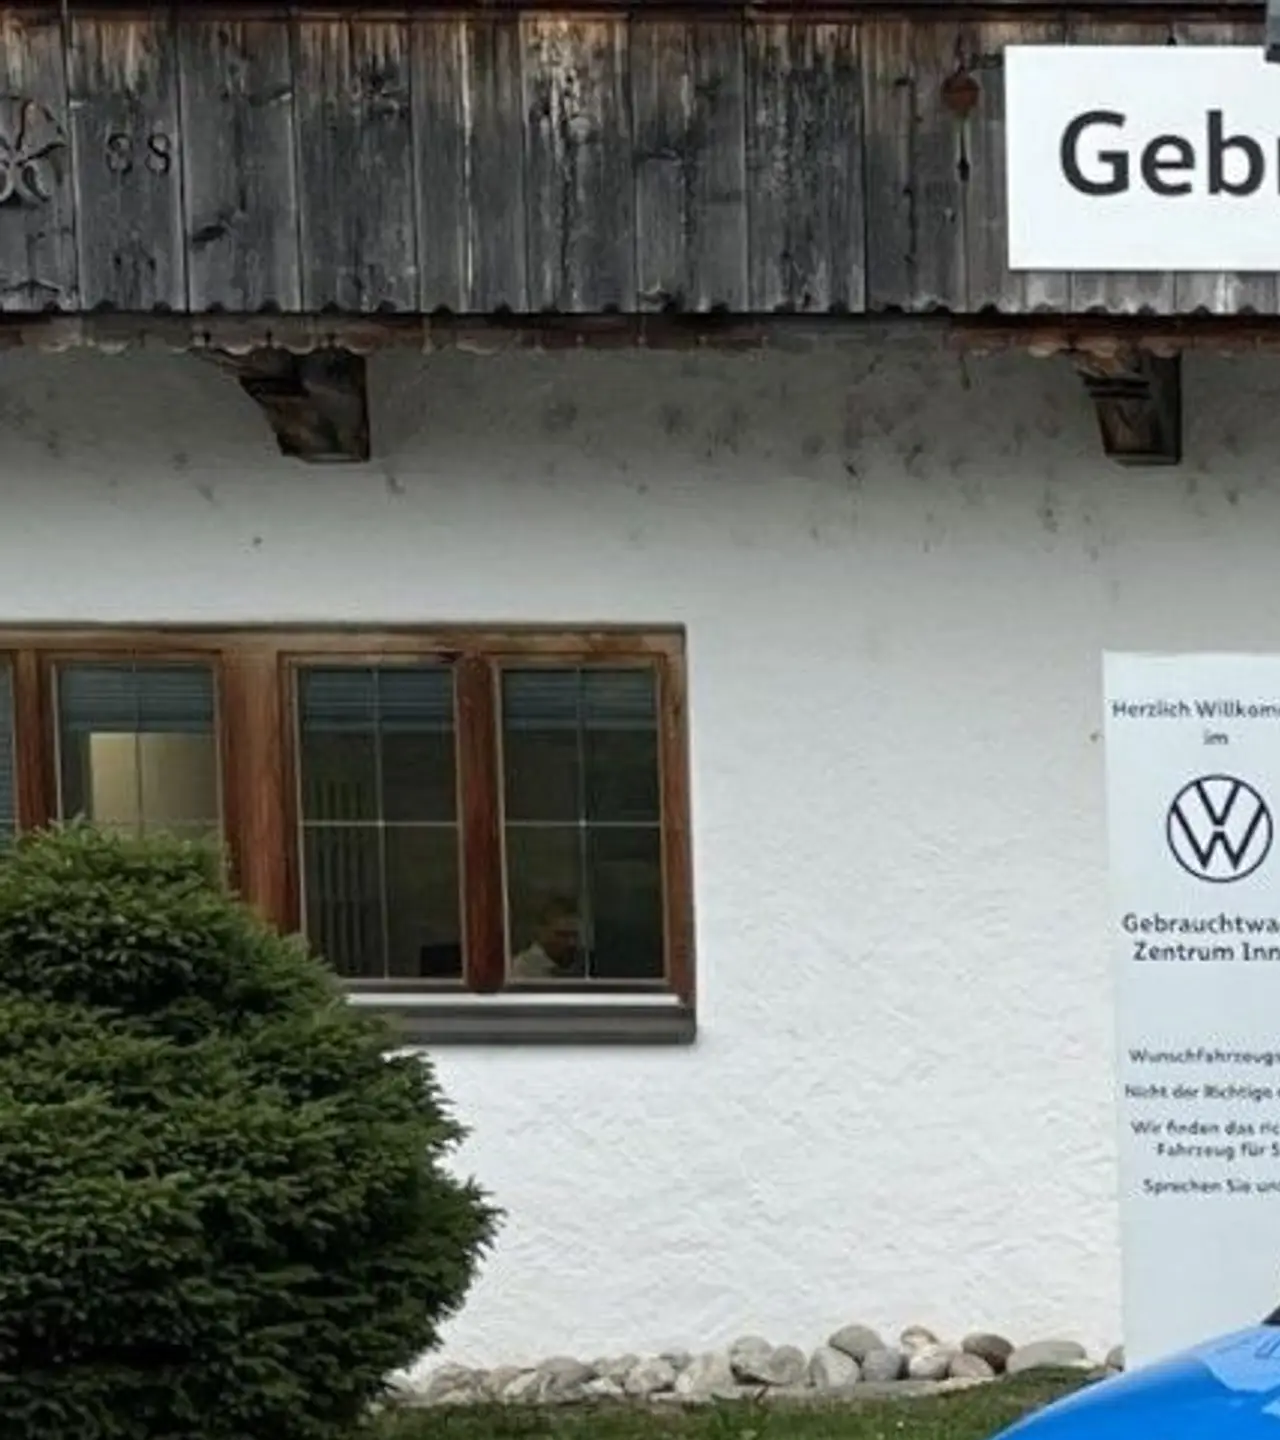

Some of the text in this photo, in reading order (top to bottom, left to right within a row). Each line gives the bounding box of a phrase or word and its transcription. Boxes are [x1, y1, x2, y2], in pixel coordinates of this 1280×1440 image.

[1112, 700, 1190, 718] Herzlich
[1203, 731, 1228, 746] im
[1133, 941, 1234, 961] Zentrum
[1125, 1084, 1168, 1099] Nicht
[1172, 1084, 1199, 1099] der
[1204, 1084, 1272, 1101] Richtige
[1131, 1120, 1162, 1135] Wir
[1166, 1119, 1219, 1135] finden
[1224, 1120, 1254, 1135] das
[1155, 1142, 1235, 1161] Fahrzeug
[1241, 1142, 1265, 1157] für
[1142, 1178, 1222, 1196] Sprechen
[1226, 1178, 1251, 1193] Sie
